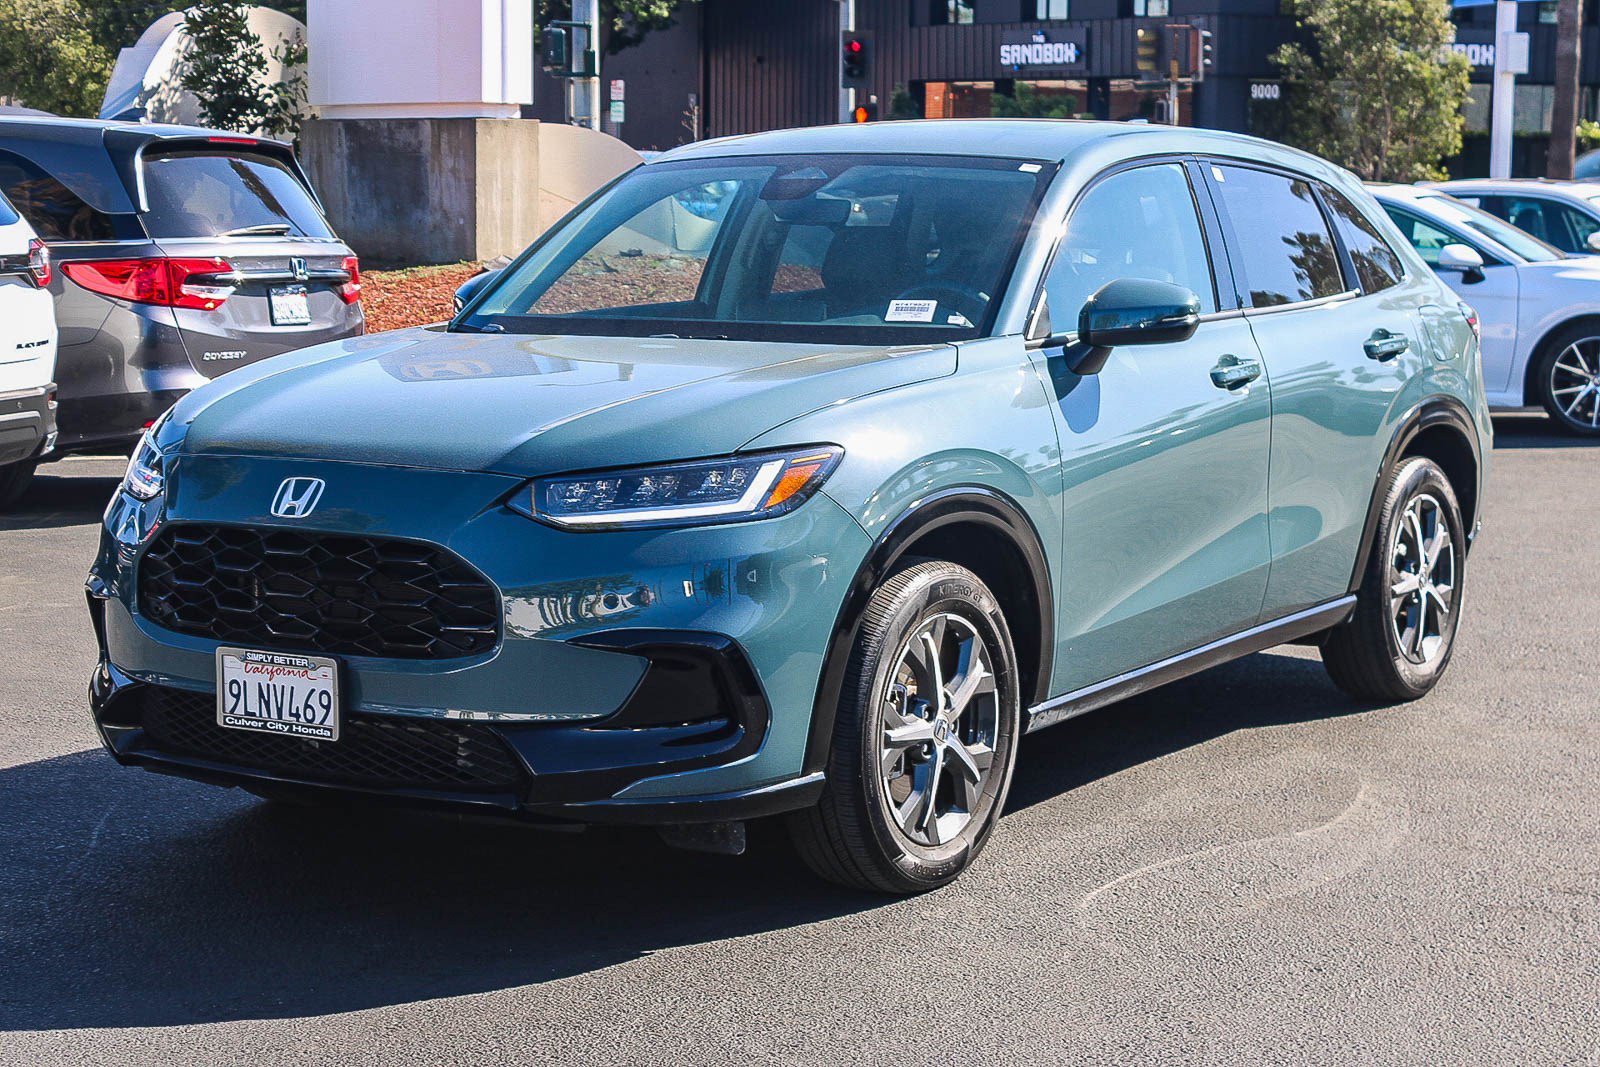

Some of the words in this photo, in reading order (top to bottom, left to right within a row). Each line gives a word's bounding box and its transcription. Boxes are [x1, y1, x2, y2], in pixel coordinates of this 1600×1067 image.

[1000, 43, 1076, 65] SANDBOX
[1250, 83, 1280, 99] 9000
[202, 350, 247, 361] ODYSSEY
[246, 652, 273, 663] SIMPLY
[273, 655, 309, 667] BETTER
[243, 661, 317, 681] California
[228, 678, 332, 725] 9LNV469
[225, 716, 264, 728] Culver
[266, 721, 290, 732] City
[292, 722, 331, 736] Honda
